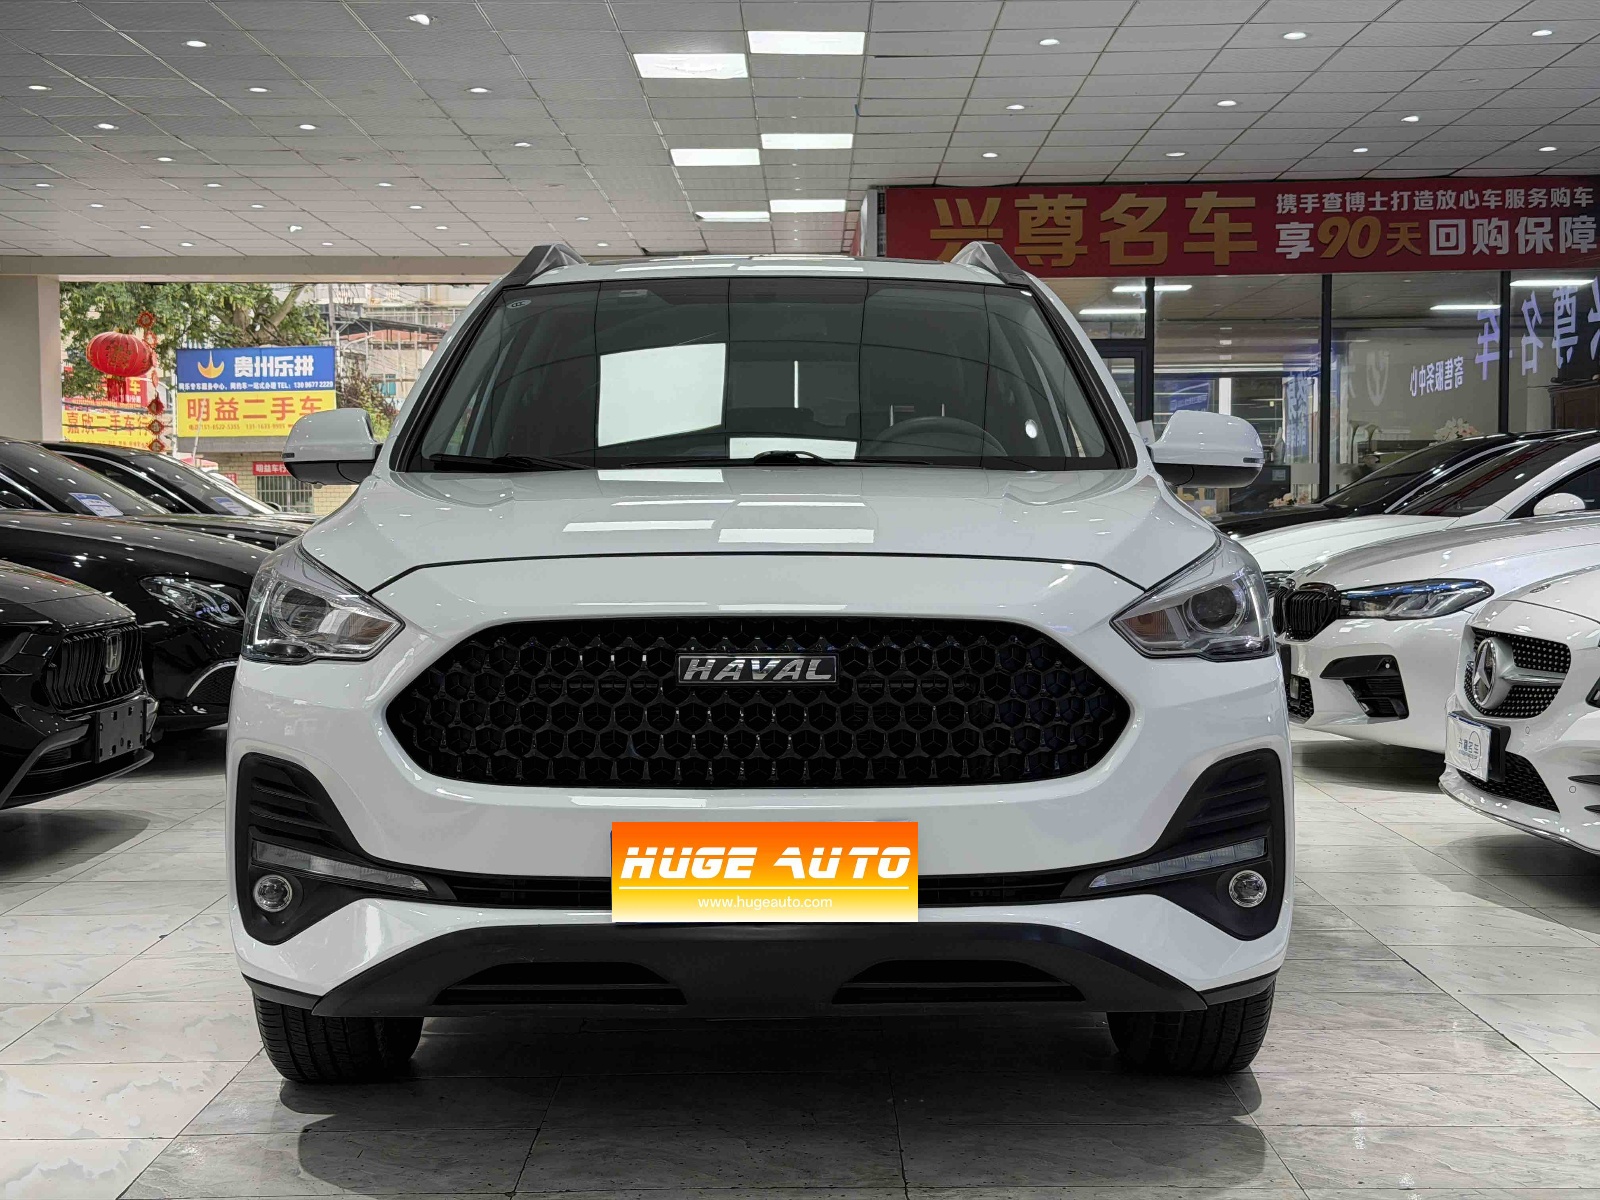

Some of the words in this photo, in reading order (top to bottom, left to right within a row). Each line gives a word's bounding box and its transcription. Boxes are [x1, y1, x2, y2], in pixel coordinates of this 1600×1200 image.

[1276, 187, 1595, 215] 携手查博士打造放心车服务购车
[930, 193, 1258, 266] 兴尊名车
[1276, 216, 1597, 260] 享90天回购保障
[234, 355, 314, 377] 贵州乐拼
[187, 396, 322, 421] 明益二手车
[683, 658, 833, 681] HAVAL
